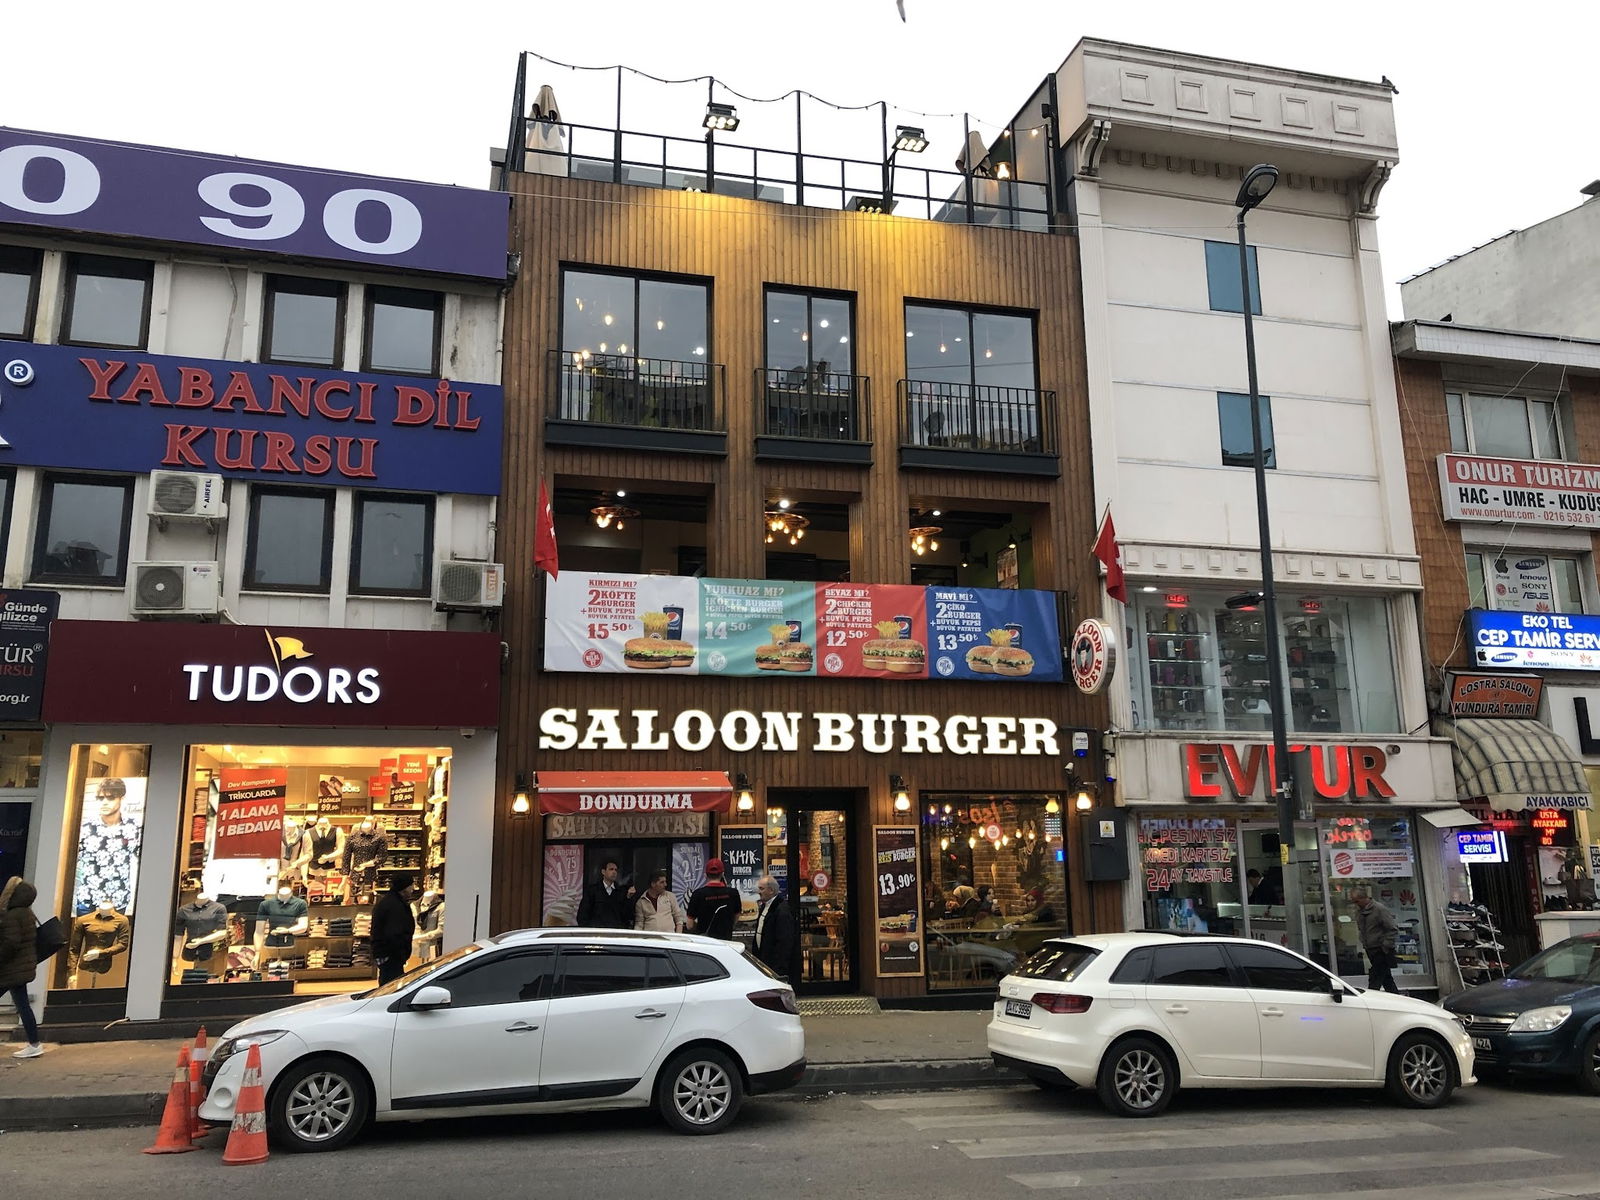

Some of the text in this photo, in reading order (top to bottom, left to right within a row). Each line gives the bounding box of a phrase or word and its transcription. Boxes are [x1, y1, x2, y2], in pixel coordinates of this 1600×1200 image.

[197, 172, 423, 255] 90
[79, 357, 482, 431] YABANCI DİL
[161, 424, 380, 479] KURSU
[1455, 460, 1516, 484] ONUR
[1458, 486, 1489, 505] HAC
[1502, 489, 1546, 509] UMRE
[1460, 507, 1596, 524] www.onurtur.com 0216 532 61
[588, 589, 601, 606] 2
[825, 589, 852, 597] BEYAZ
[5, 602, 48, 614] Günde
[601, 599, 636, 608] BURGER
[825, 599, 871, 615] 2 CHICKEN
[936, 602, 947, 618] 2
[947, 611, 981, 619] BURGER
[1522, 614, 1573, 629] EKO TEL
[1477, 628, 1509, 646] CEP
[1511, 628, 1562, 648] TAMİR
[182, 664, 381, 704] TUDORS
[1460, 679, 1535, 698] LOSTRA SALONU
[1453, 702, 1500, 714] KUNDURA
[538, 707, 1061, 756] SALOON BURGER
[228, 789, 277, 800] TRİKOLARDA
[579, 793, 694, 811] DONDURMA
[1526, 796, 1589, 807] AYAKKABICI
[220, 803, 279, 820] 1 ALANA
[217, 819, 282, 837] 1 BEDAVA
[620, 815, 705, 836] NOKTASI
[1458, 834, 1471, 843] CEP
[1182, 848, 1231, 862] KARTSIZ
[1146, 869, 1171, 891] 24
